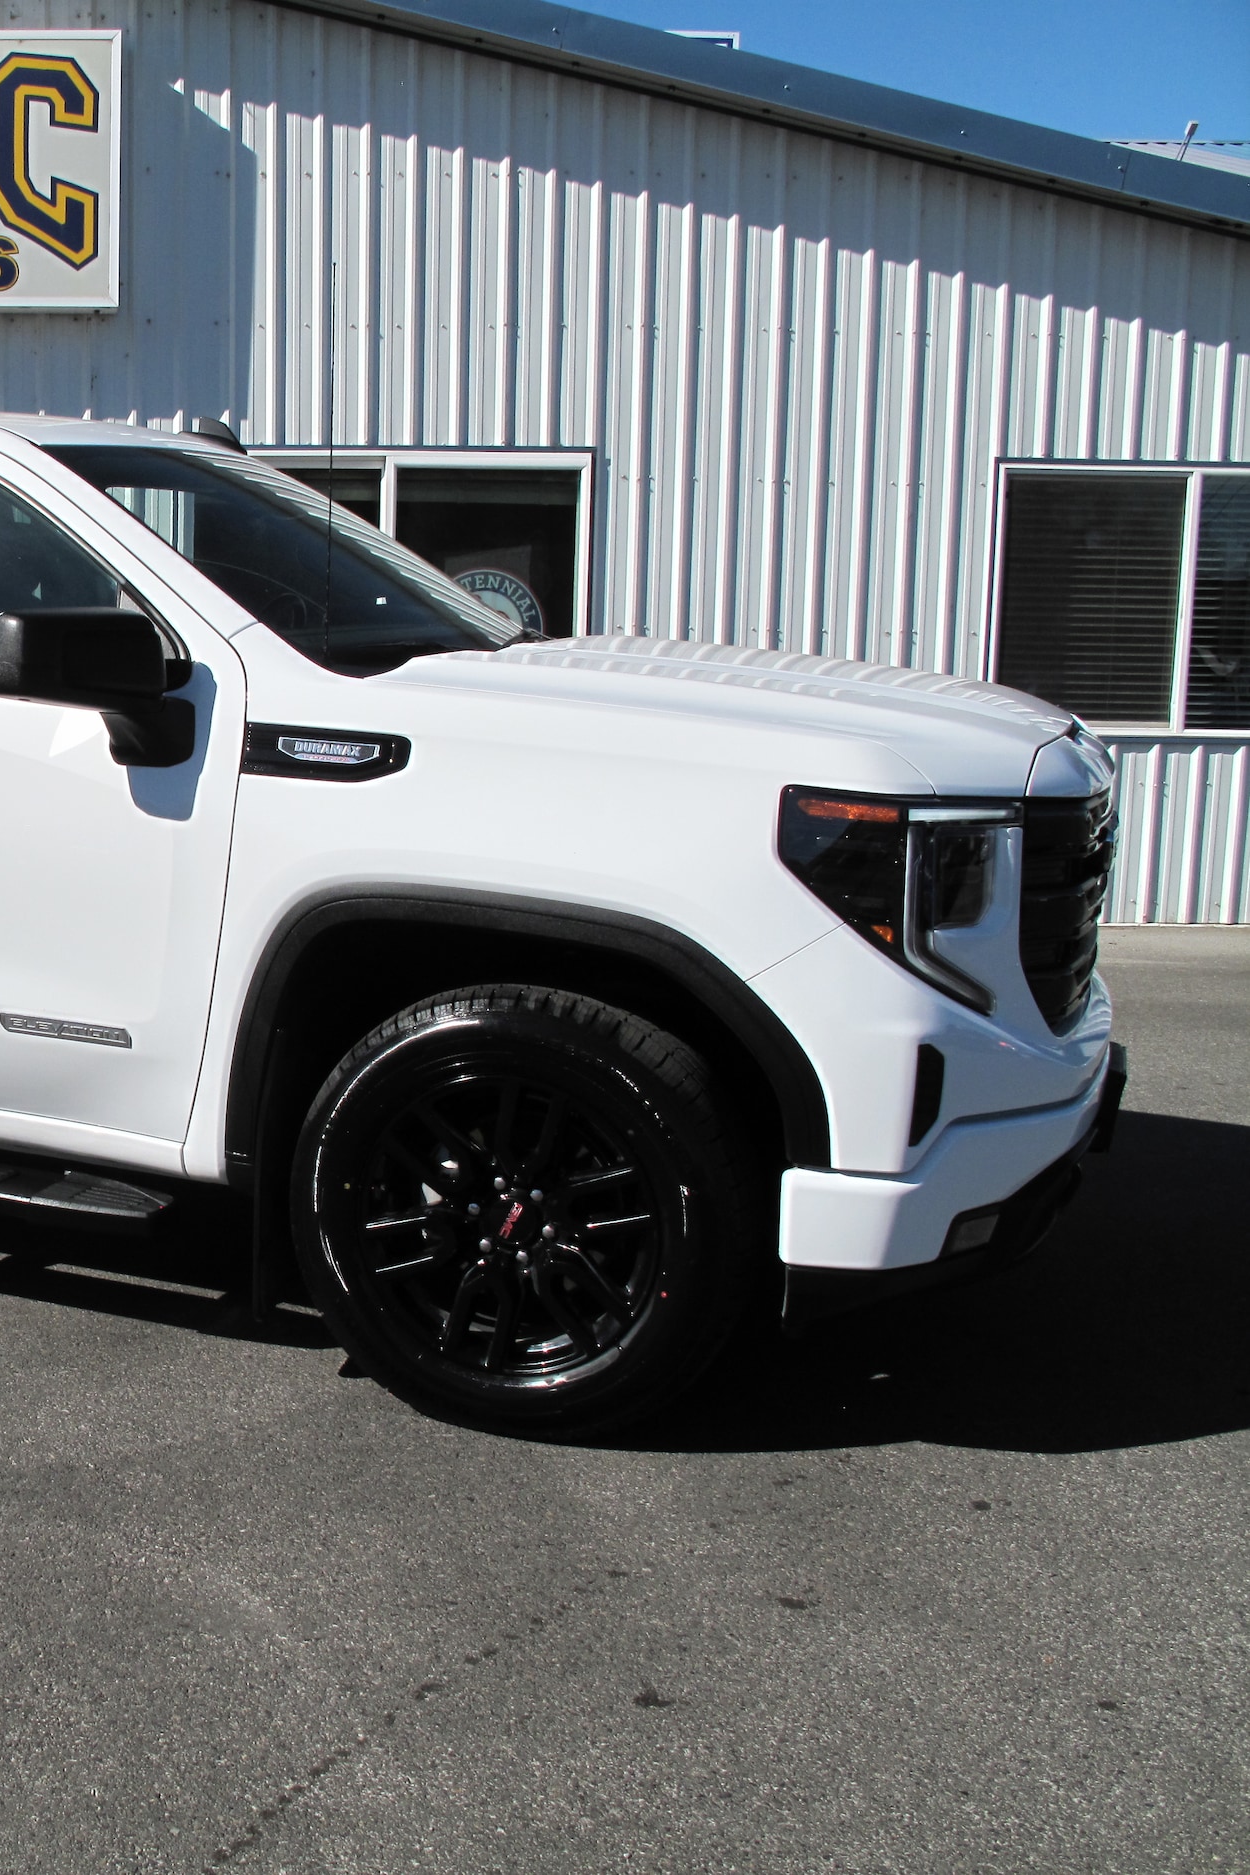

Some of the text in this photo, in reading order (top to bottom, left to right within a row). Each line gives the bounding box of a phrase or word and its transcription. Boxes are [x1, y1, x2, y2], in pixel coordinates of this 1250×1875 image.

[460, 575, 536, 622] TENNIAL
[294, 740, 362, 757] DURAMAX
[9, 1017, 120, 1040] ELEVATION
[499, 1202, 524, 1239] GMC
